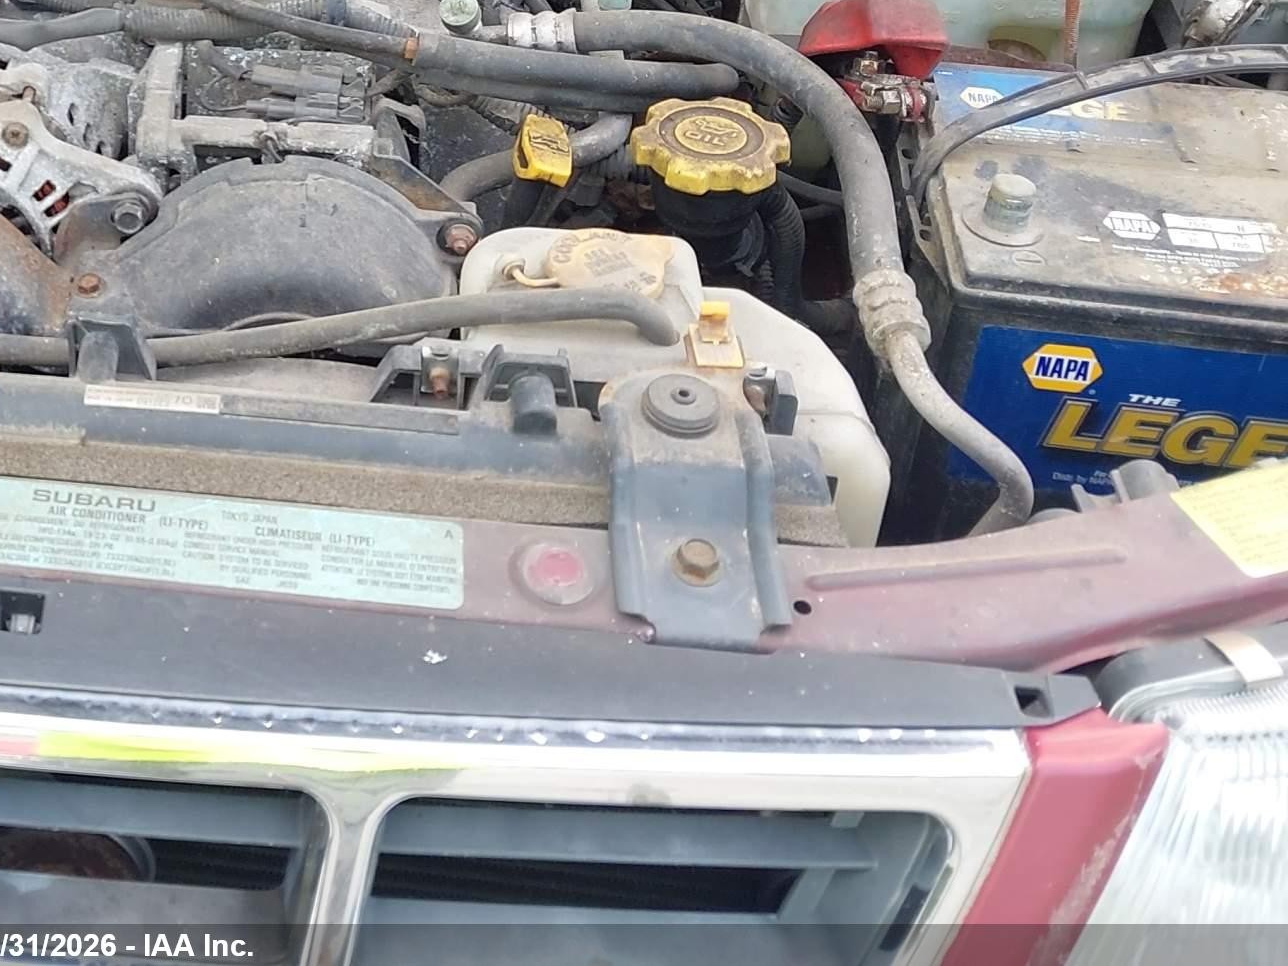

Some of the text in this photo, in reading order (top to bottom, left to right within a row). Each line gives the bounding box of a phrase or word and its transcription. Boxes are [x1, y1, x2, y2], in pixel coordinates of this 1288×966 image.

[684, 130, 726, 147] OIL
[1034, 356, 1090, 381] NAPA
[1128, 393, 1182, 408] THE
[31, 489, 157, 513] SUBARU
[48, 505, 67, 516] AIR
[71, 508, 147, 525] CONDITIONER
[254, 525, 323, 542] CLIMATISEUR
